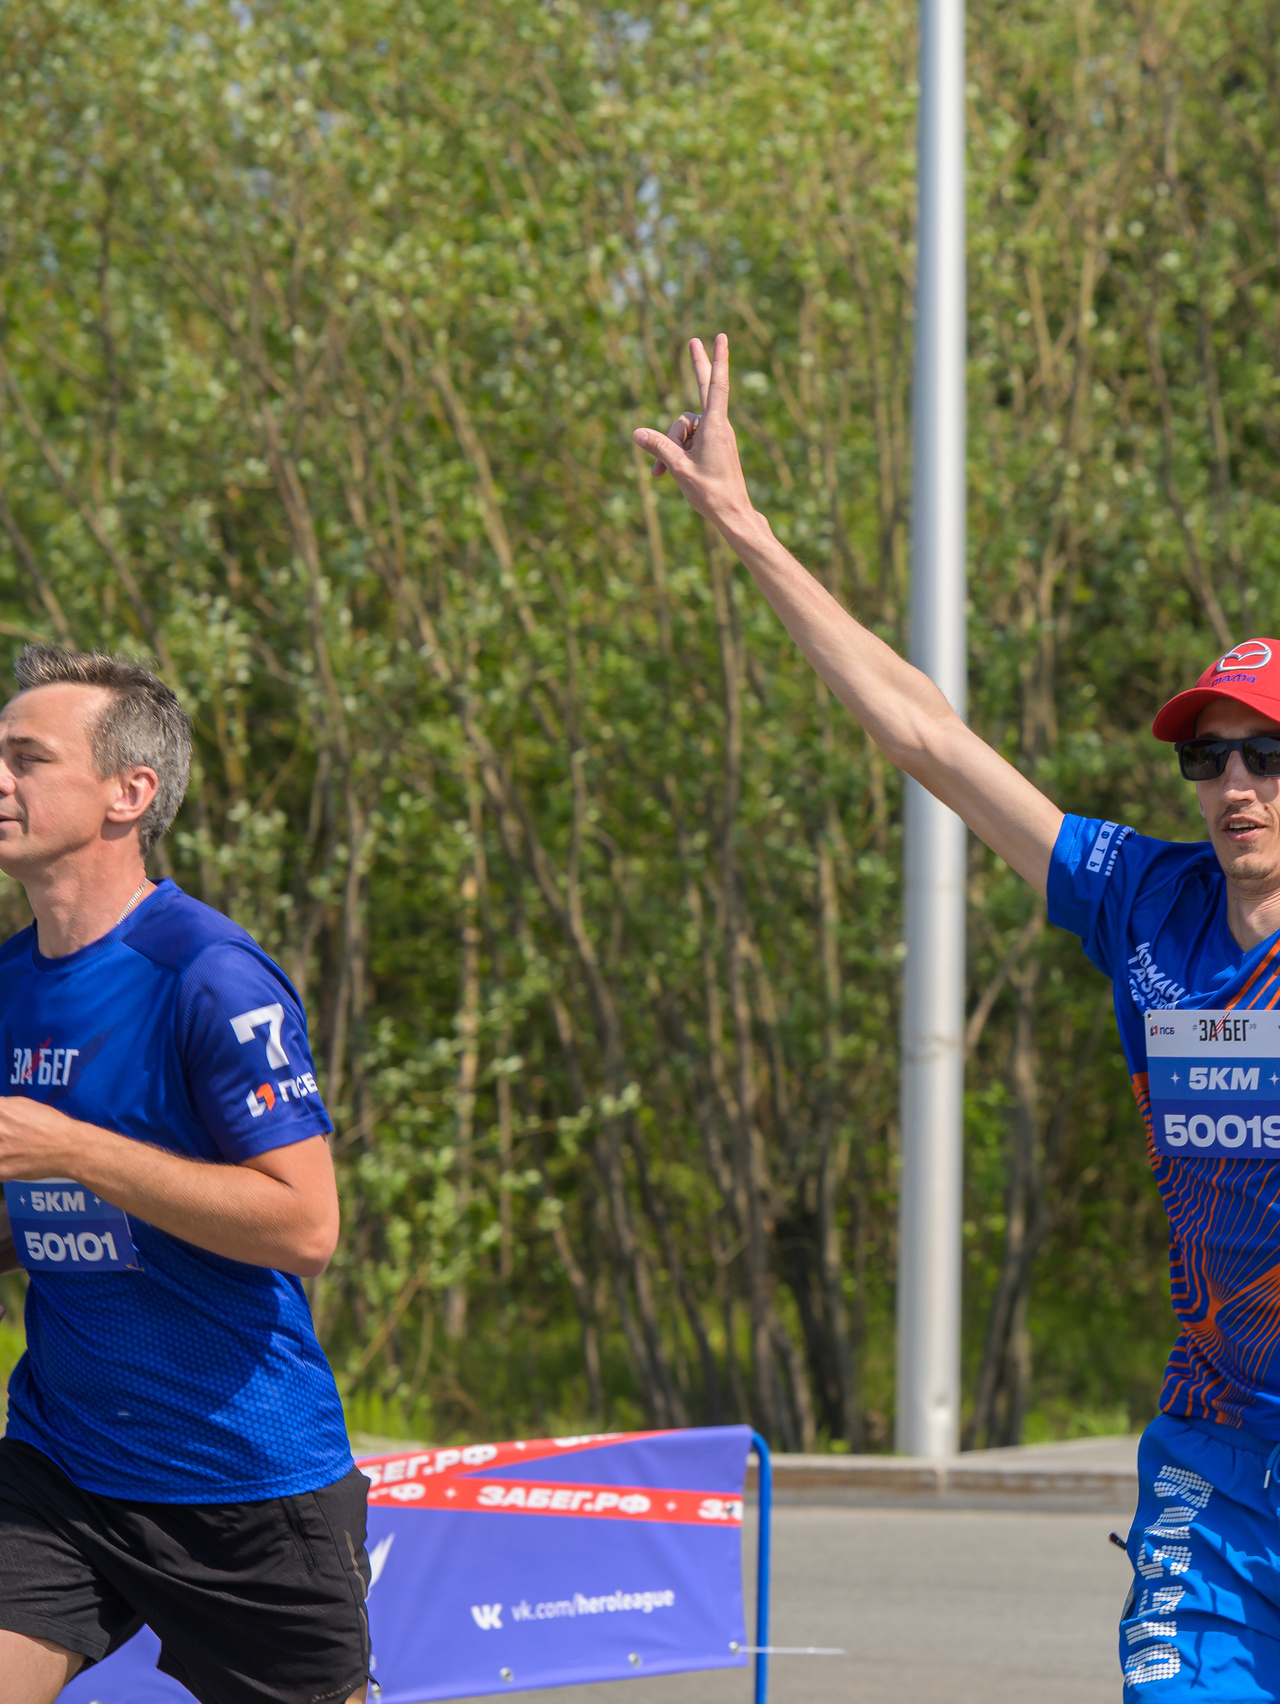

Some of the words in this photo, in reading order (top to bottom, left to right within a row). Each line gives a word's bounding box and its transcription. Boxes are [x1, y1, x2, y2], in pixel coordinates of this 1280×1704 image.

[229, 1002, 290, 1070] 7
[277, 1071, 319, 1103] ПСБ
[24, 1231, 119, 1263] 50101
[476, 1485, 651, 1515] ЗАБЕГ.РФ
[511, 1588, 675, 1621] vk.com/heroleague
